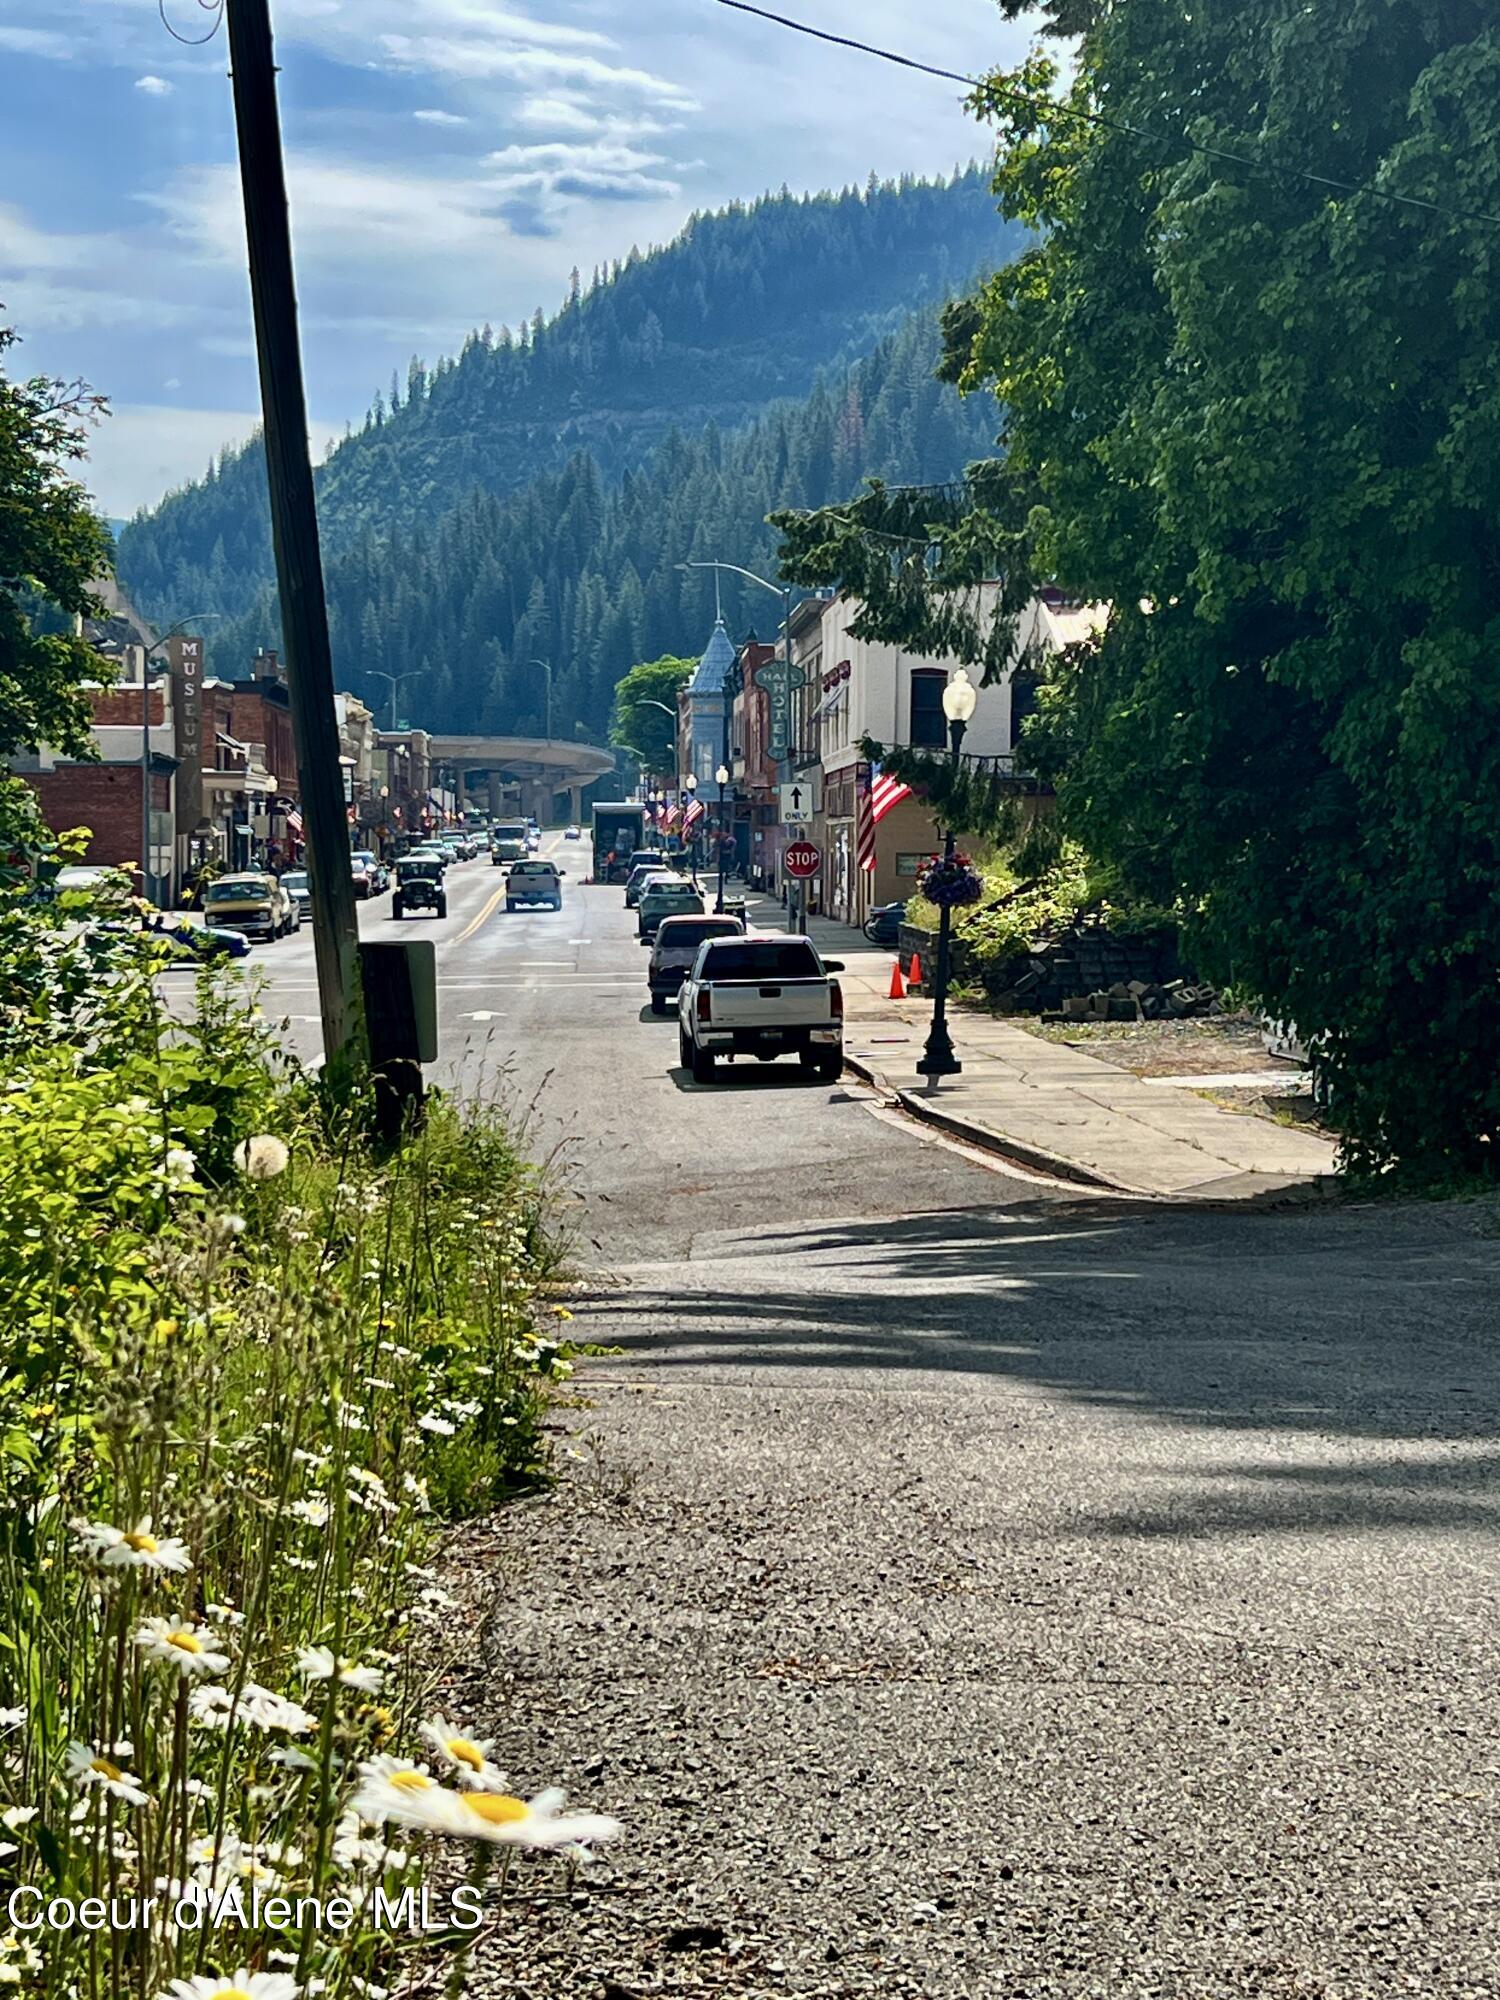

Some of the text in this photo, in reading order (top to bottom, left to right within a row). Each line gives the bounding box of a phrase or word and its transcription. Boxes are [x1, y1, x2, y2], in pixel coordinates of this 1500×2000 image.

[181, 642, 199, 757] MUSEUM
[772, 682, 785, 748] HOTEL
[784, 811, 808, 820] ONLY
[786, 851, 818, 866] STOP
